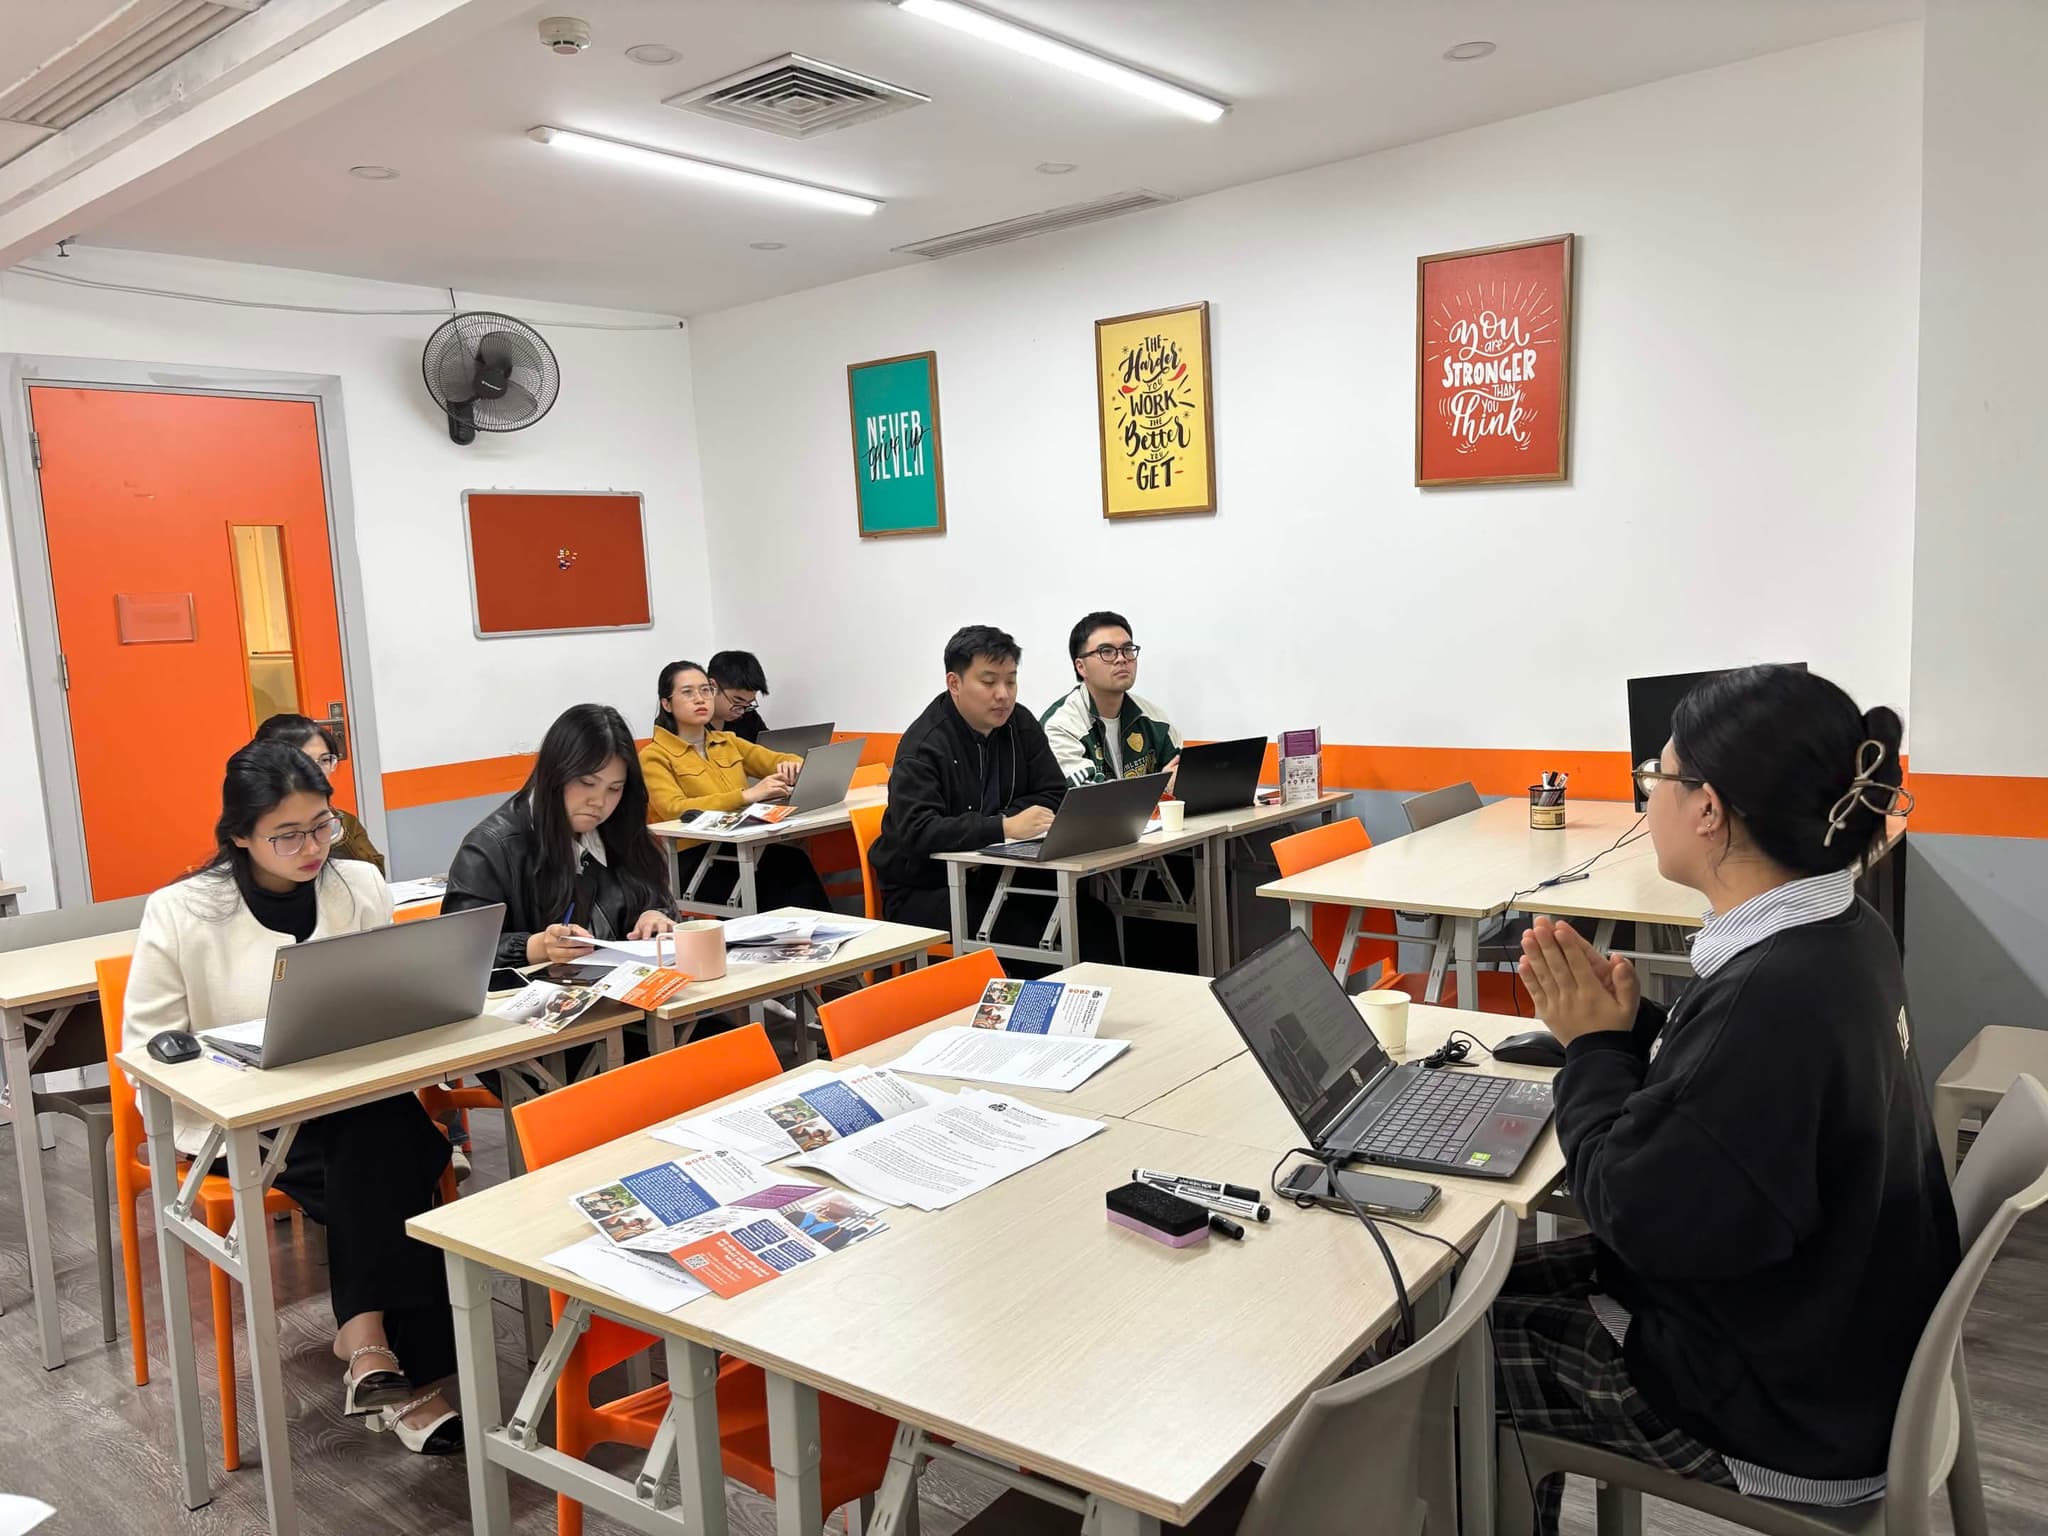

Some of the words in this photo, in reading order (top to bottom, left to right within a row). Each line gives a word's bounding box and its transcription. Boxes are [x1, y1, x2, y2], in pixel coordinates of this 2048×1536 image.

[1144, 334, 1161, 352] THE
[1484, 339, 1502, 352] are
[1119, 341, 1181, 383] Harder
[1442, 349, 1537, 388] STRONGER
[1147, 378, 1163, 391] YOU
[1492, 383, 1515, 397] THAN
[1130, 388, 1178, 417] WORK
[1482, 399, 1498, 412] YOU
[1149, 417, 1162, 427] THE
[1125, 415, 1191, 457] Better
[1136, 456, 1175, 490] GET
